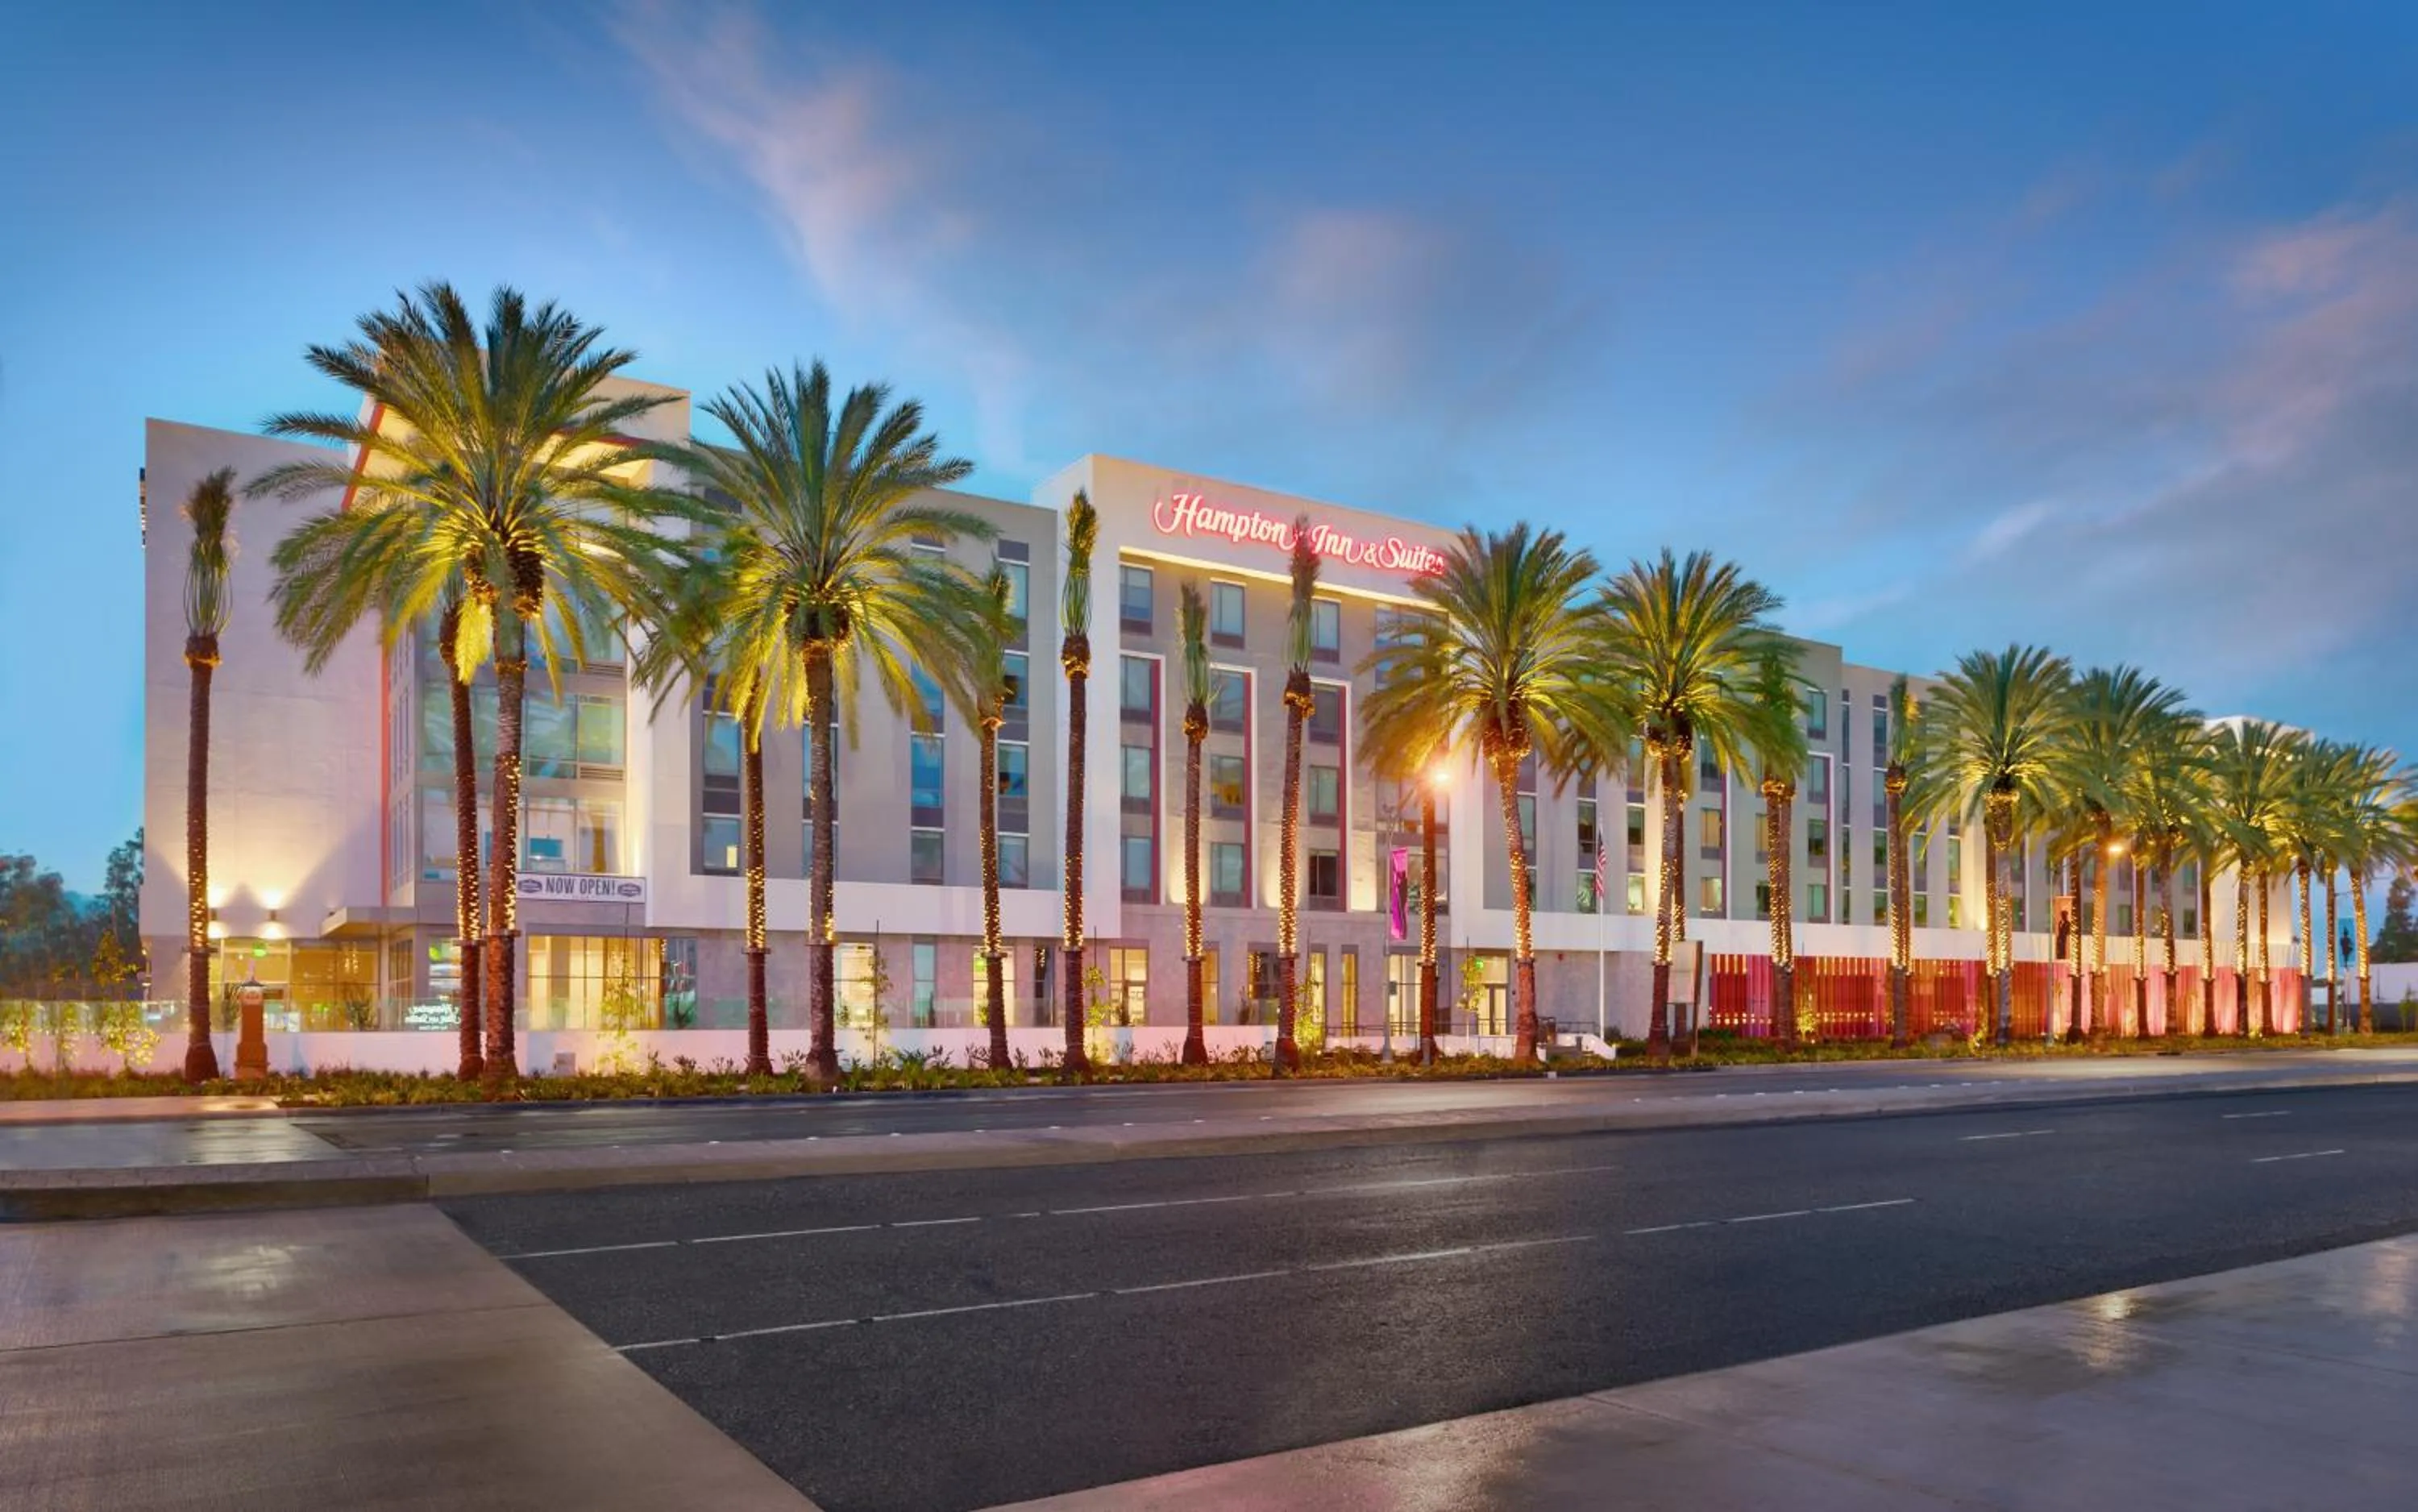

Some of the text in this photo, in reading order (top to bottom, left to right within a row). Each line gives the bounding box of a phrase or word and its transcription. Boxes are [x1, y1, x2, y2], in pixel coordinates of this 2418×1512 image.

[1154, 493, 1298, 551] Hampton
[1311, 524, 1365, 563] Inn
[546, 876, 575, 894] NOW
[580, 878, 615, 896] OPEN!
